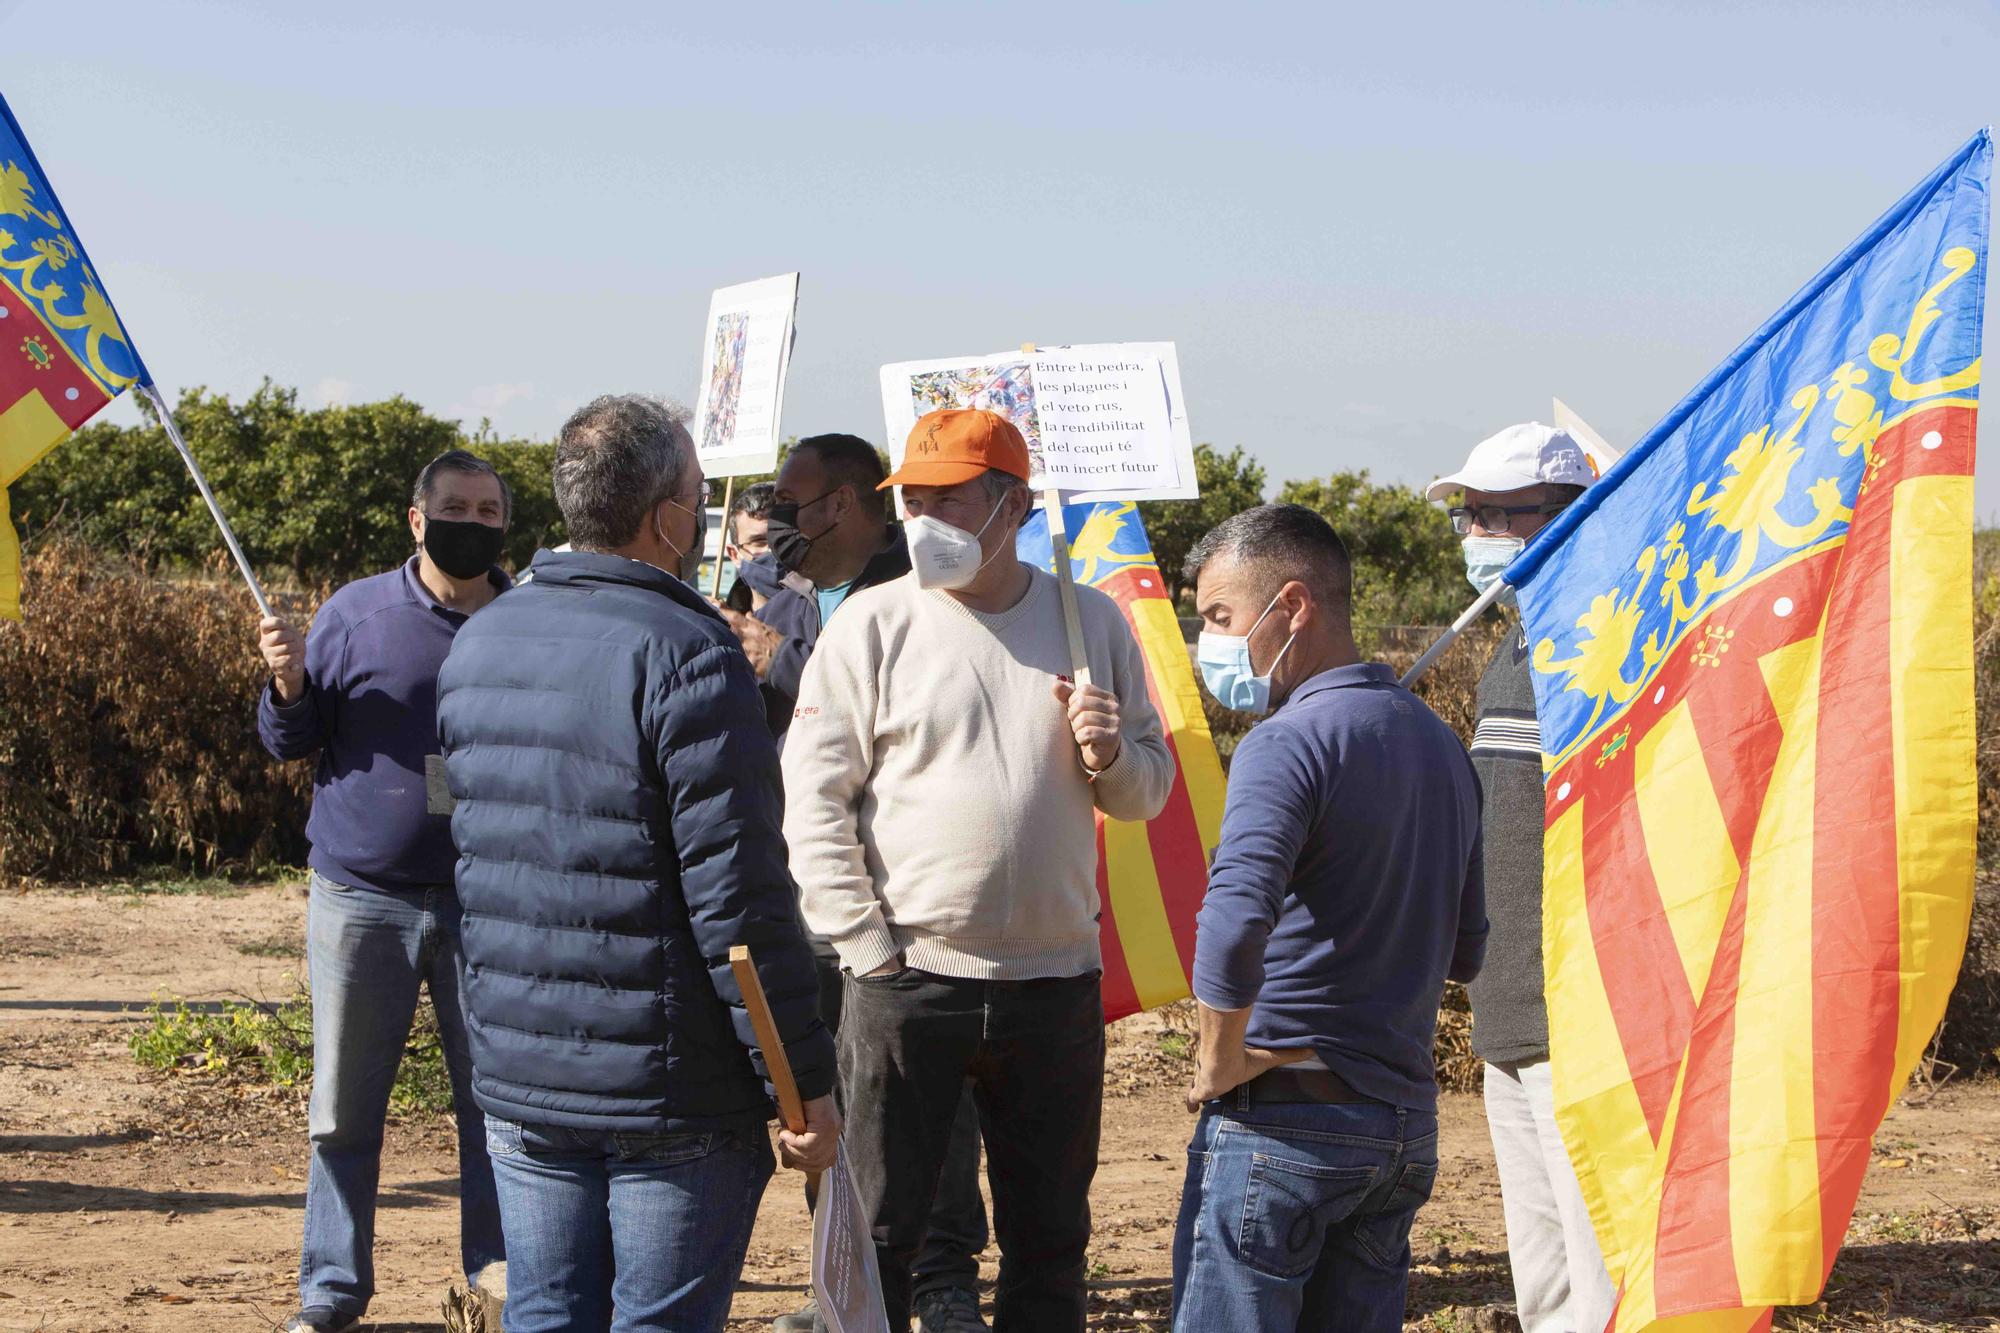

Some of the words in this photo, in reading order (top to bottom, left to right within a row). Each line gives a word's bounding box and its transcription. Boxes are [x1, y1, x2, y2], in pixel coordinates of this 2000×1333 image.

[1036, 362, 1076, 372] Entre
[1081, 362, 1092, 372] la
[1098, 362, 1144, 373] pedra,
[1039, 382, 1058, 391] les
[1064, 382, 1119, 394] plagues
[1124, 381, 1127, 389] i
[1042, 402, 1054, 411] el
[1059, 404, 1089, 412] veto
[1095, 402, 1122, 411] rus,
[1045, 422, 1056, 431] la
[1062, 421, 1145, 432] rendibilitat
[916, 441, 939, 456] AVA
[1048, 442, 1068, 452] del
[1074, 442, 1113, 455] caqui
[1119, 441, 1132, 451] té
[1051, 464, 1068, 472] un
[1074, 464, 1117, 474] incert
[1122, 462, 1158, 472] futur
